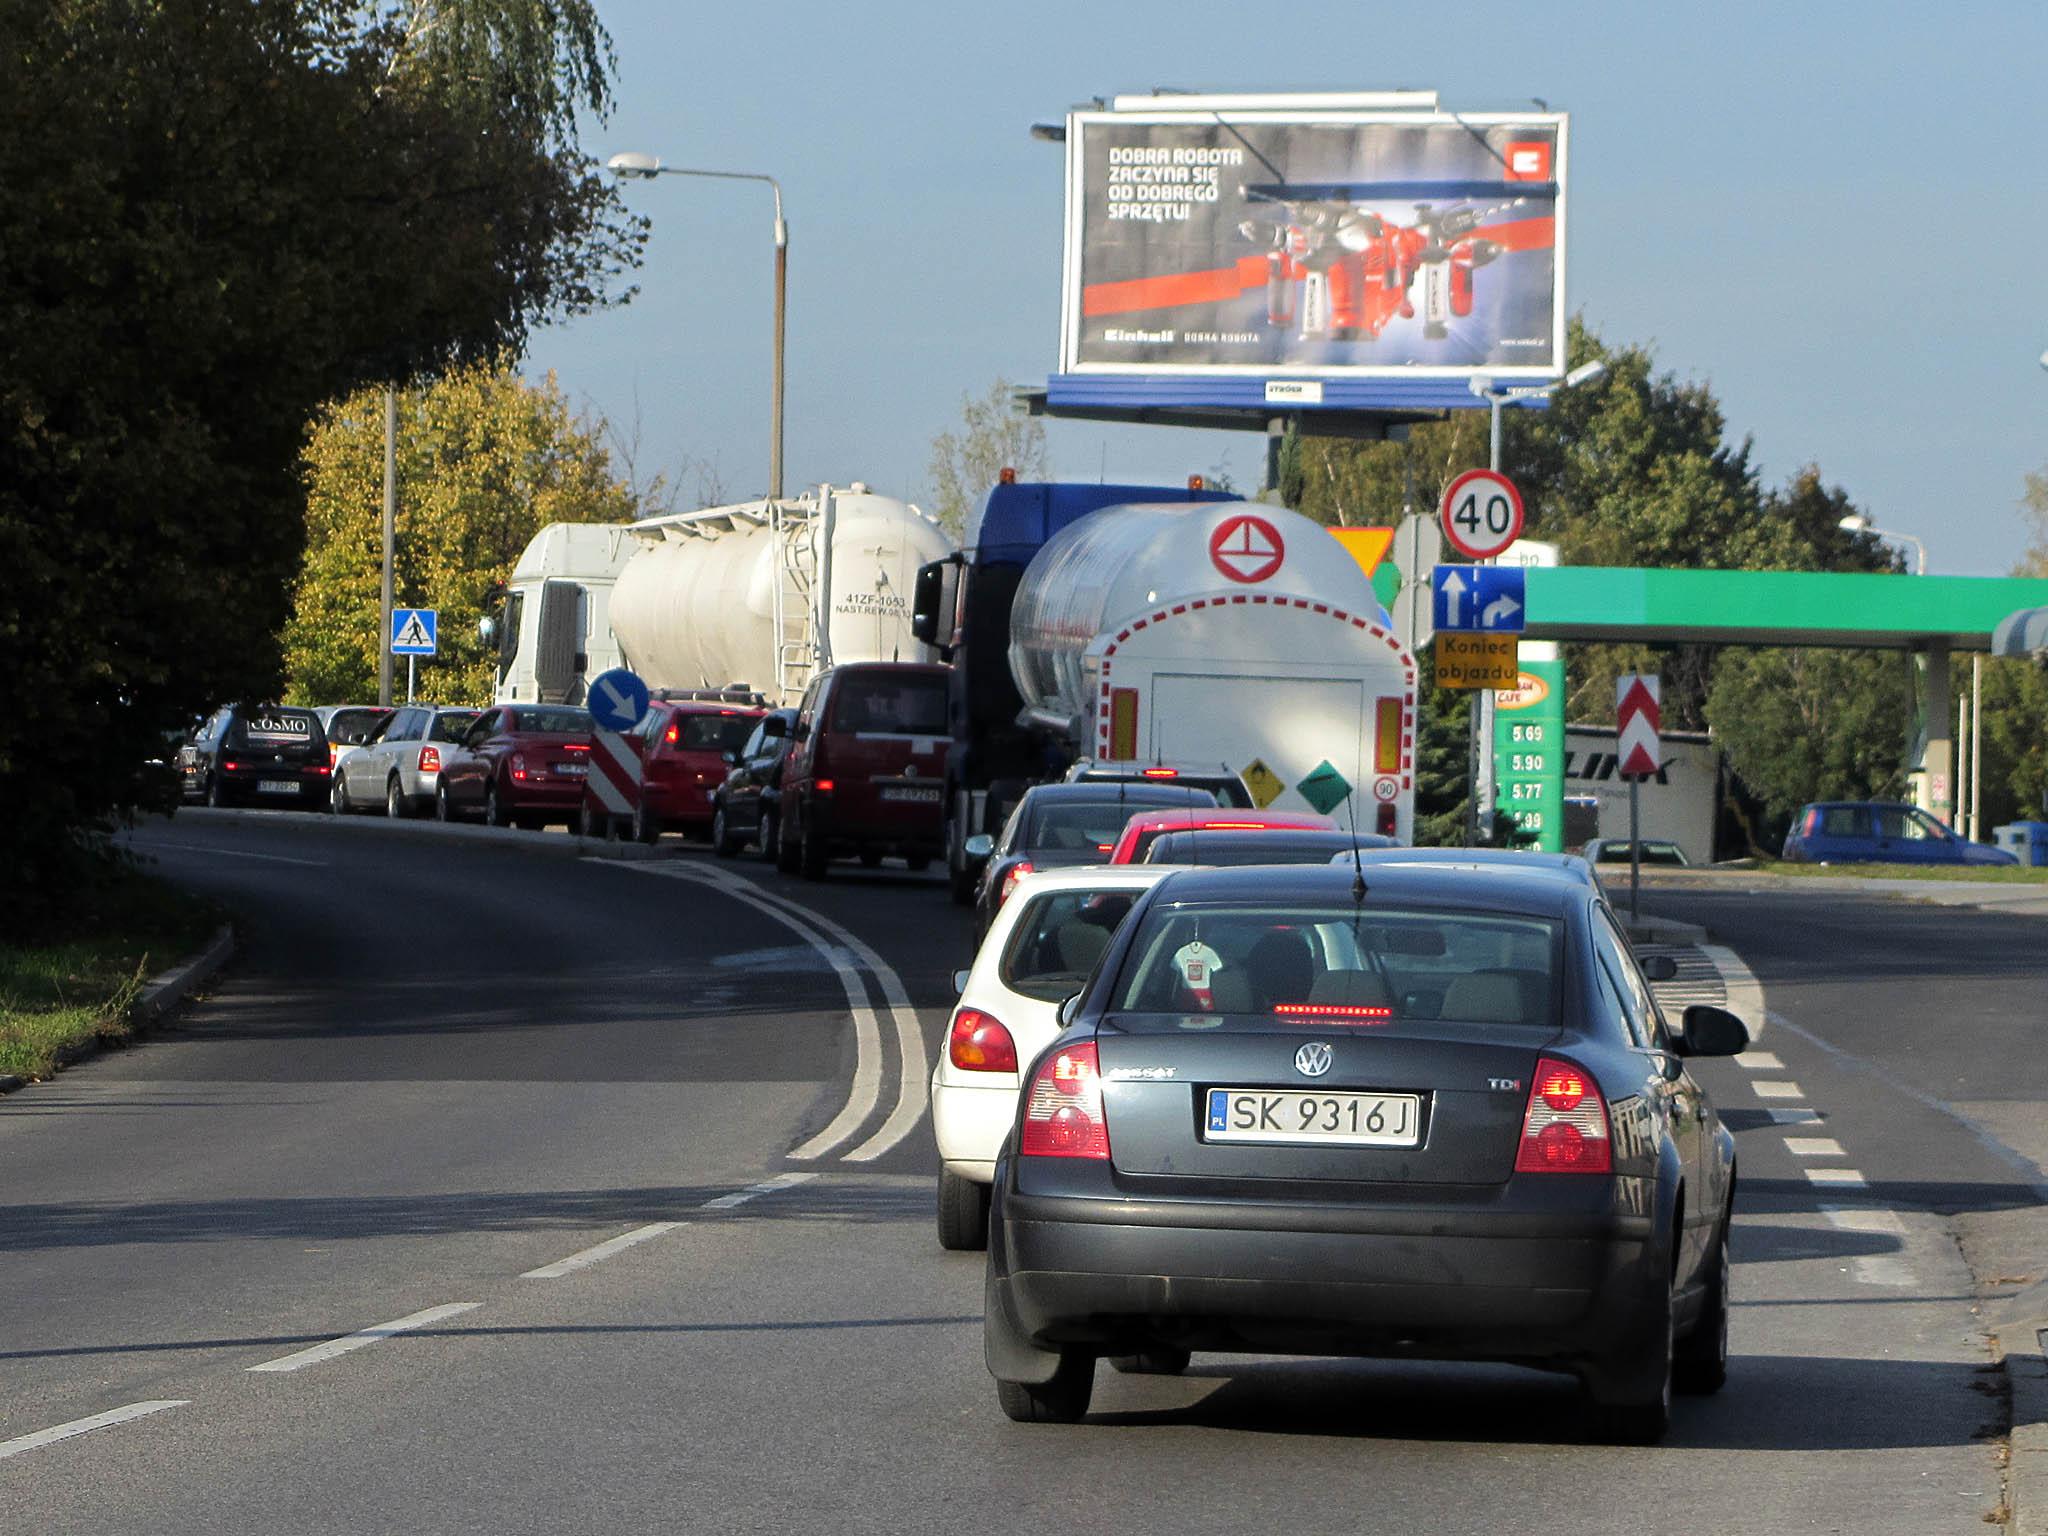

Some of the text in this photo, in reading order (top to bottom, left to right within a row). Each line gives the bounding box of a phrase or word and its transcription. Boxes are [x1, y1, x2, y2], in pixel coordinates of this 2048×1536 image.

[1109, 147, 1243, 165] DOBRA ROBOTA
[1192, 166, 1218, 185] SIĘ
[1108, 184, 1219, 201] OD DOBREGO
[1454, 493, 1510, 534] 40
[1445, 637, 1510, 655] Koniec
[1438, 664, 1515, 683] objazdu
[251, 719, 306, 732] COSMO
[1512, 725, 1543, 742] 5.69
[1512, 755, 1543, 771] 5.90
[1379, 783, 1393, 795] 90
[1512, 784, 1543, 799] 5.77
[1212, 1116, 1225, 1127] PL
[1233, 1096, 1409, 1135] SK 9316J
